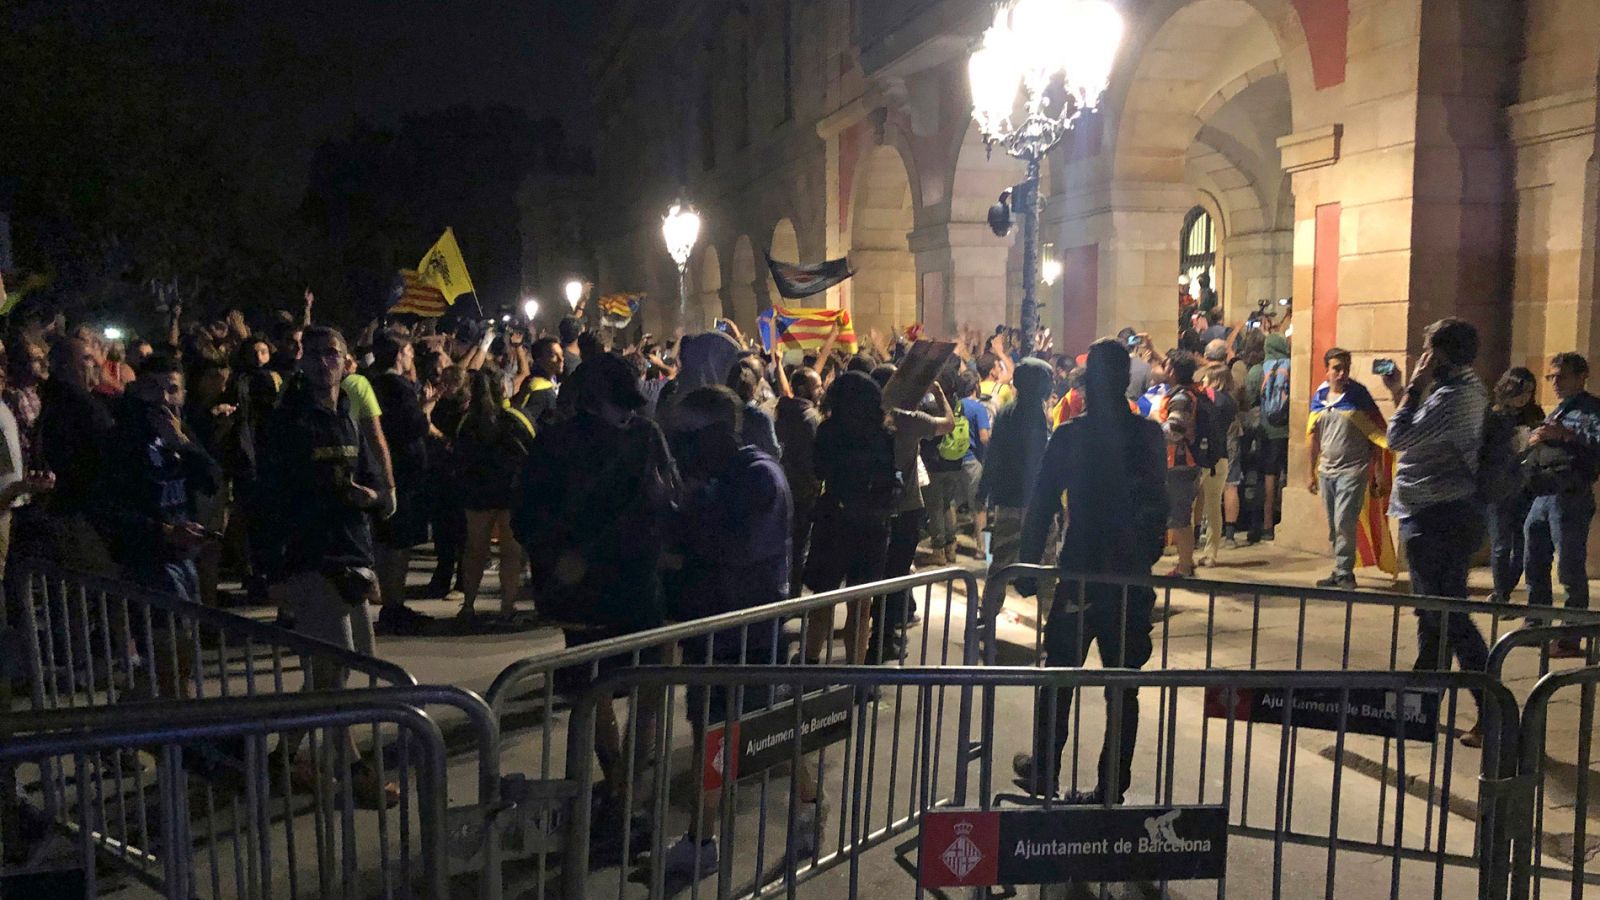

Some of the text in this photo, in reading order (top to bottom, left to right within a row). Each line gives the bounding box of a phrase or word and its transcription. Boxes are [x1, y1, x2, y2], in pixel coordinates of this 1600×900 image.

[1261, 693, 1340, 712] Ajutament
[1361, 704, 1427, 724] Barceona
[746, 728, 795, 756] Ajuntamen
[810, 709, 848, 732] Barcelona
[1014, 837, 1211, 860] Ajuntament de Barcelona
